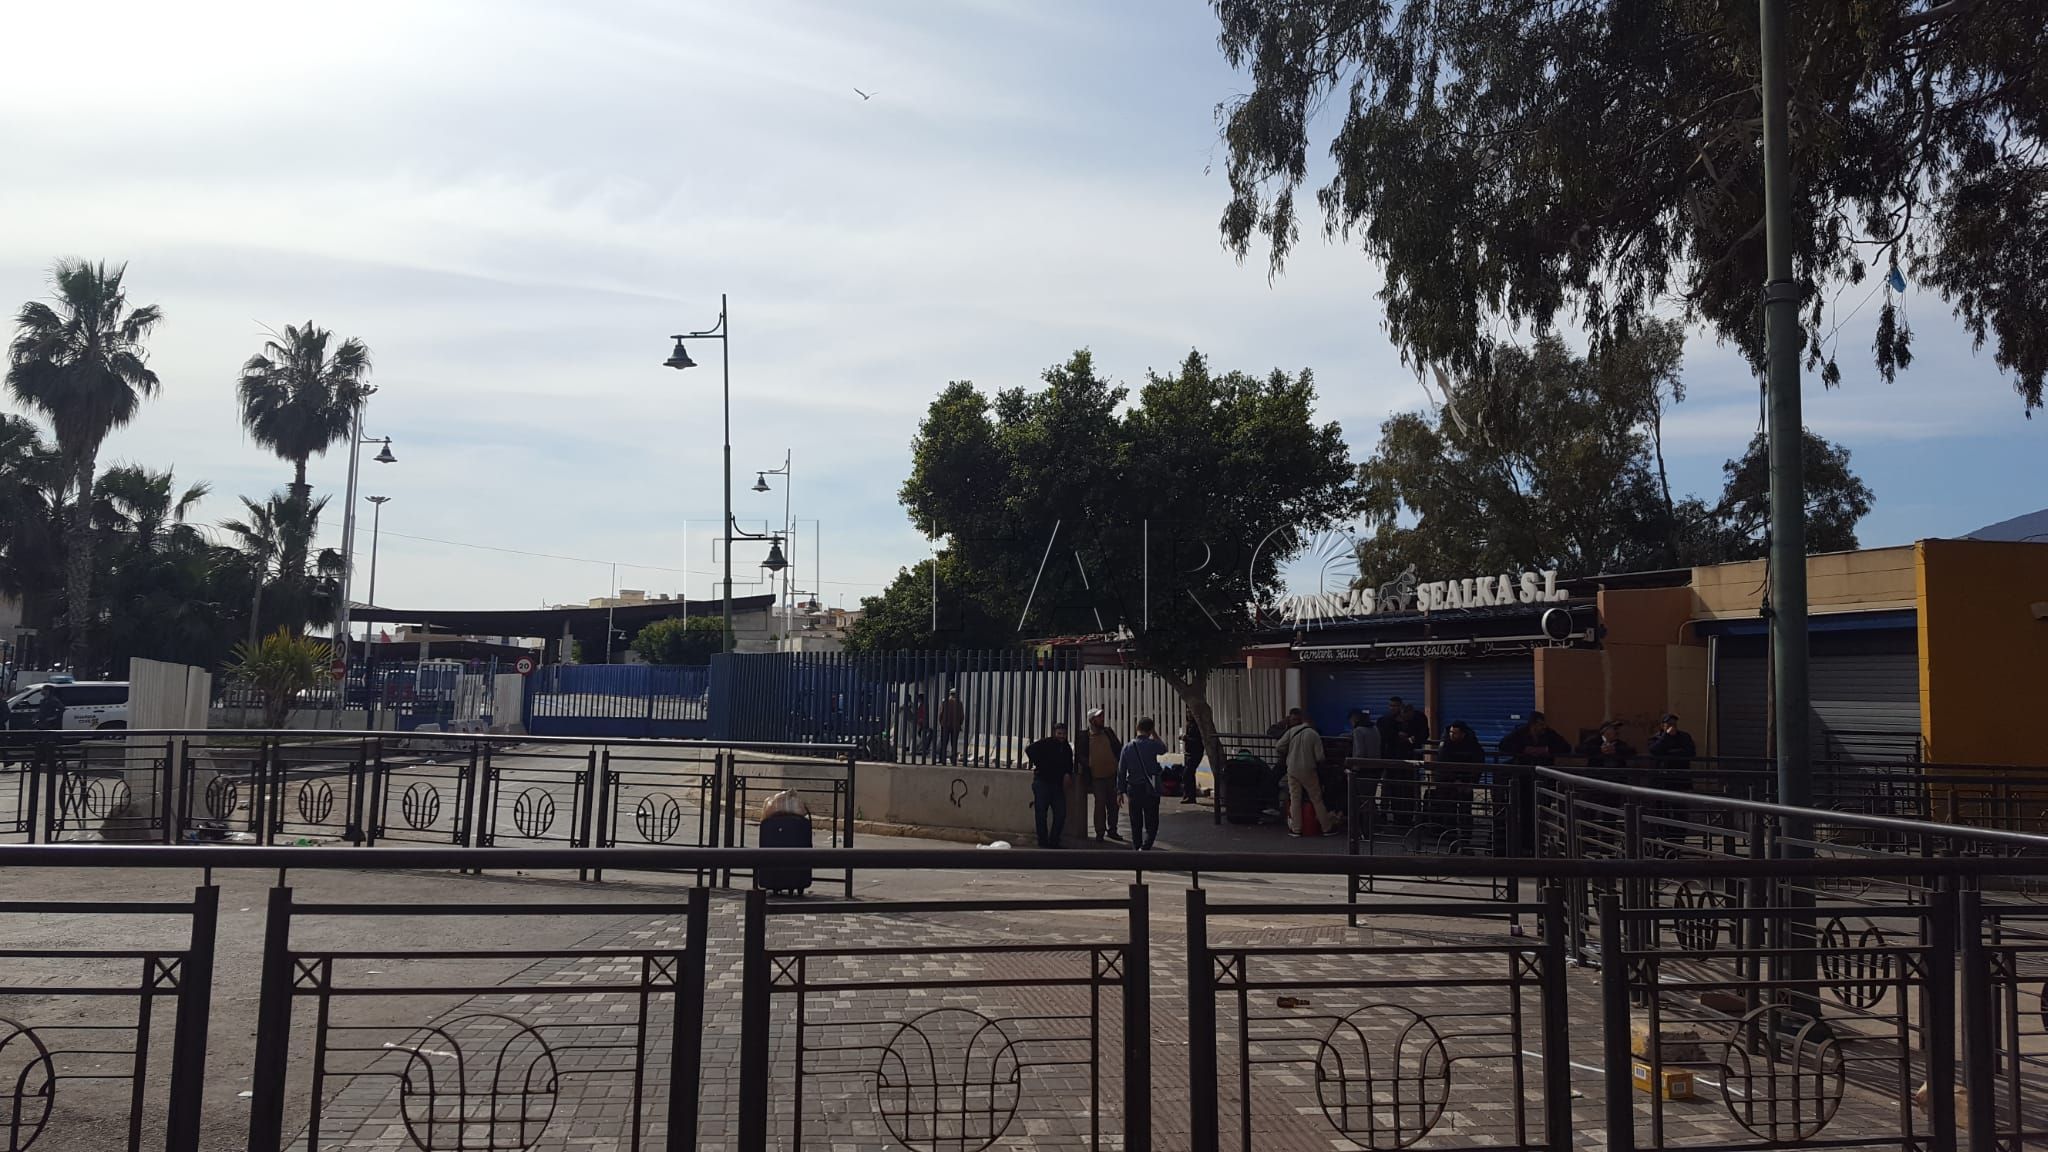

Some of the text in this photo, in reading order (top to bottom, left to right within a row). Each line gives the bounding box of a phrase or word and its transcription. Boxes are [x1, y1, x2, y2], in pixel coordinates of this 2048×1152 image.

[1417, 574, 1517, 612] SEALKA
[1520, 570, 1570, 604] S.L.
[519, 662, 530, 670] 20
